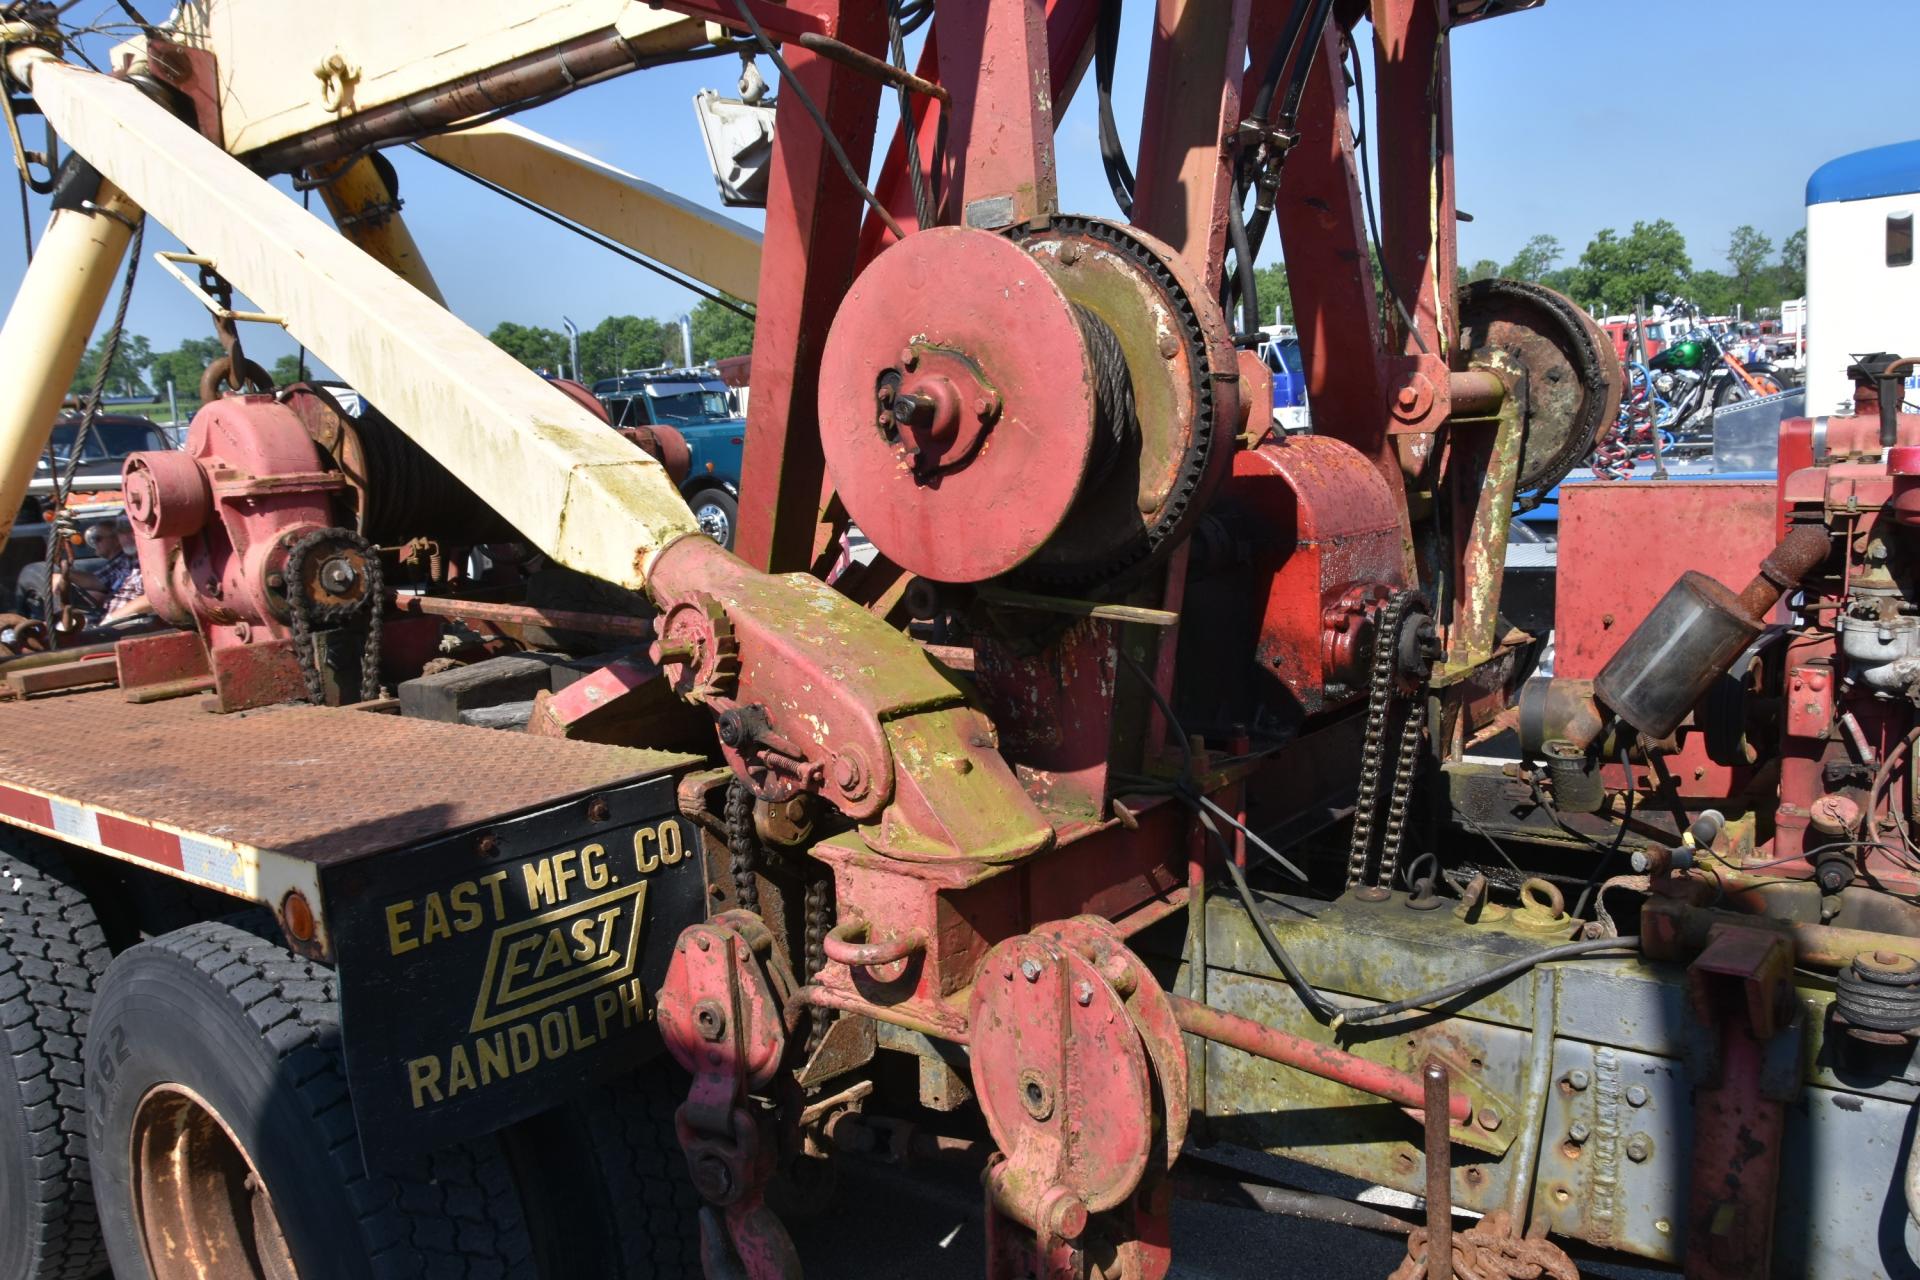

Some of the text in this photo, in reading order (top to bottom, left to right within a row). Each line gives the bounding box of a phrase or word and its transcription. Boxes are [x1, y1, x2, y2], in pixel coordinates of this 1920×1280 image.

[385, 819, 692, 956] EAST MFG. CO.
[496, 907, 622, 1005] EAST
